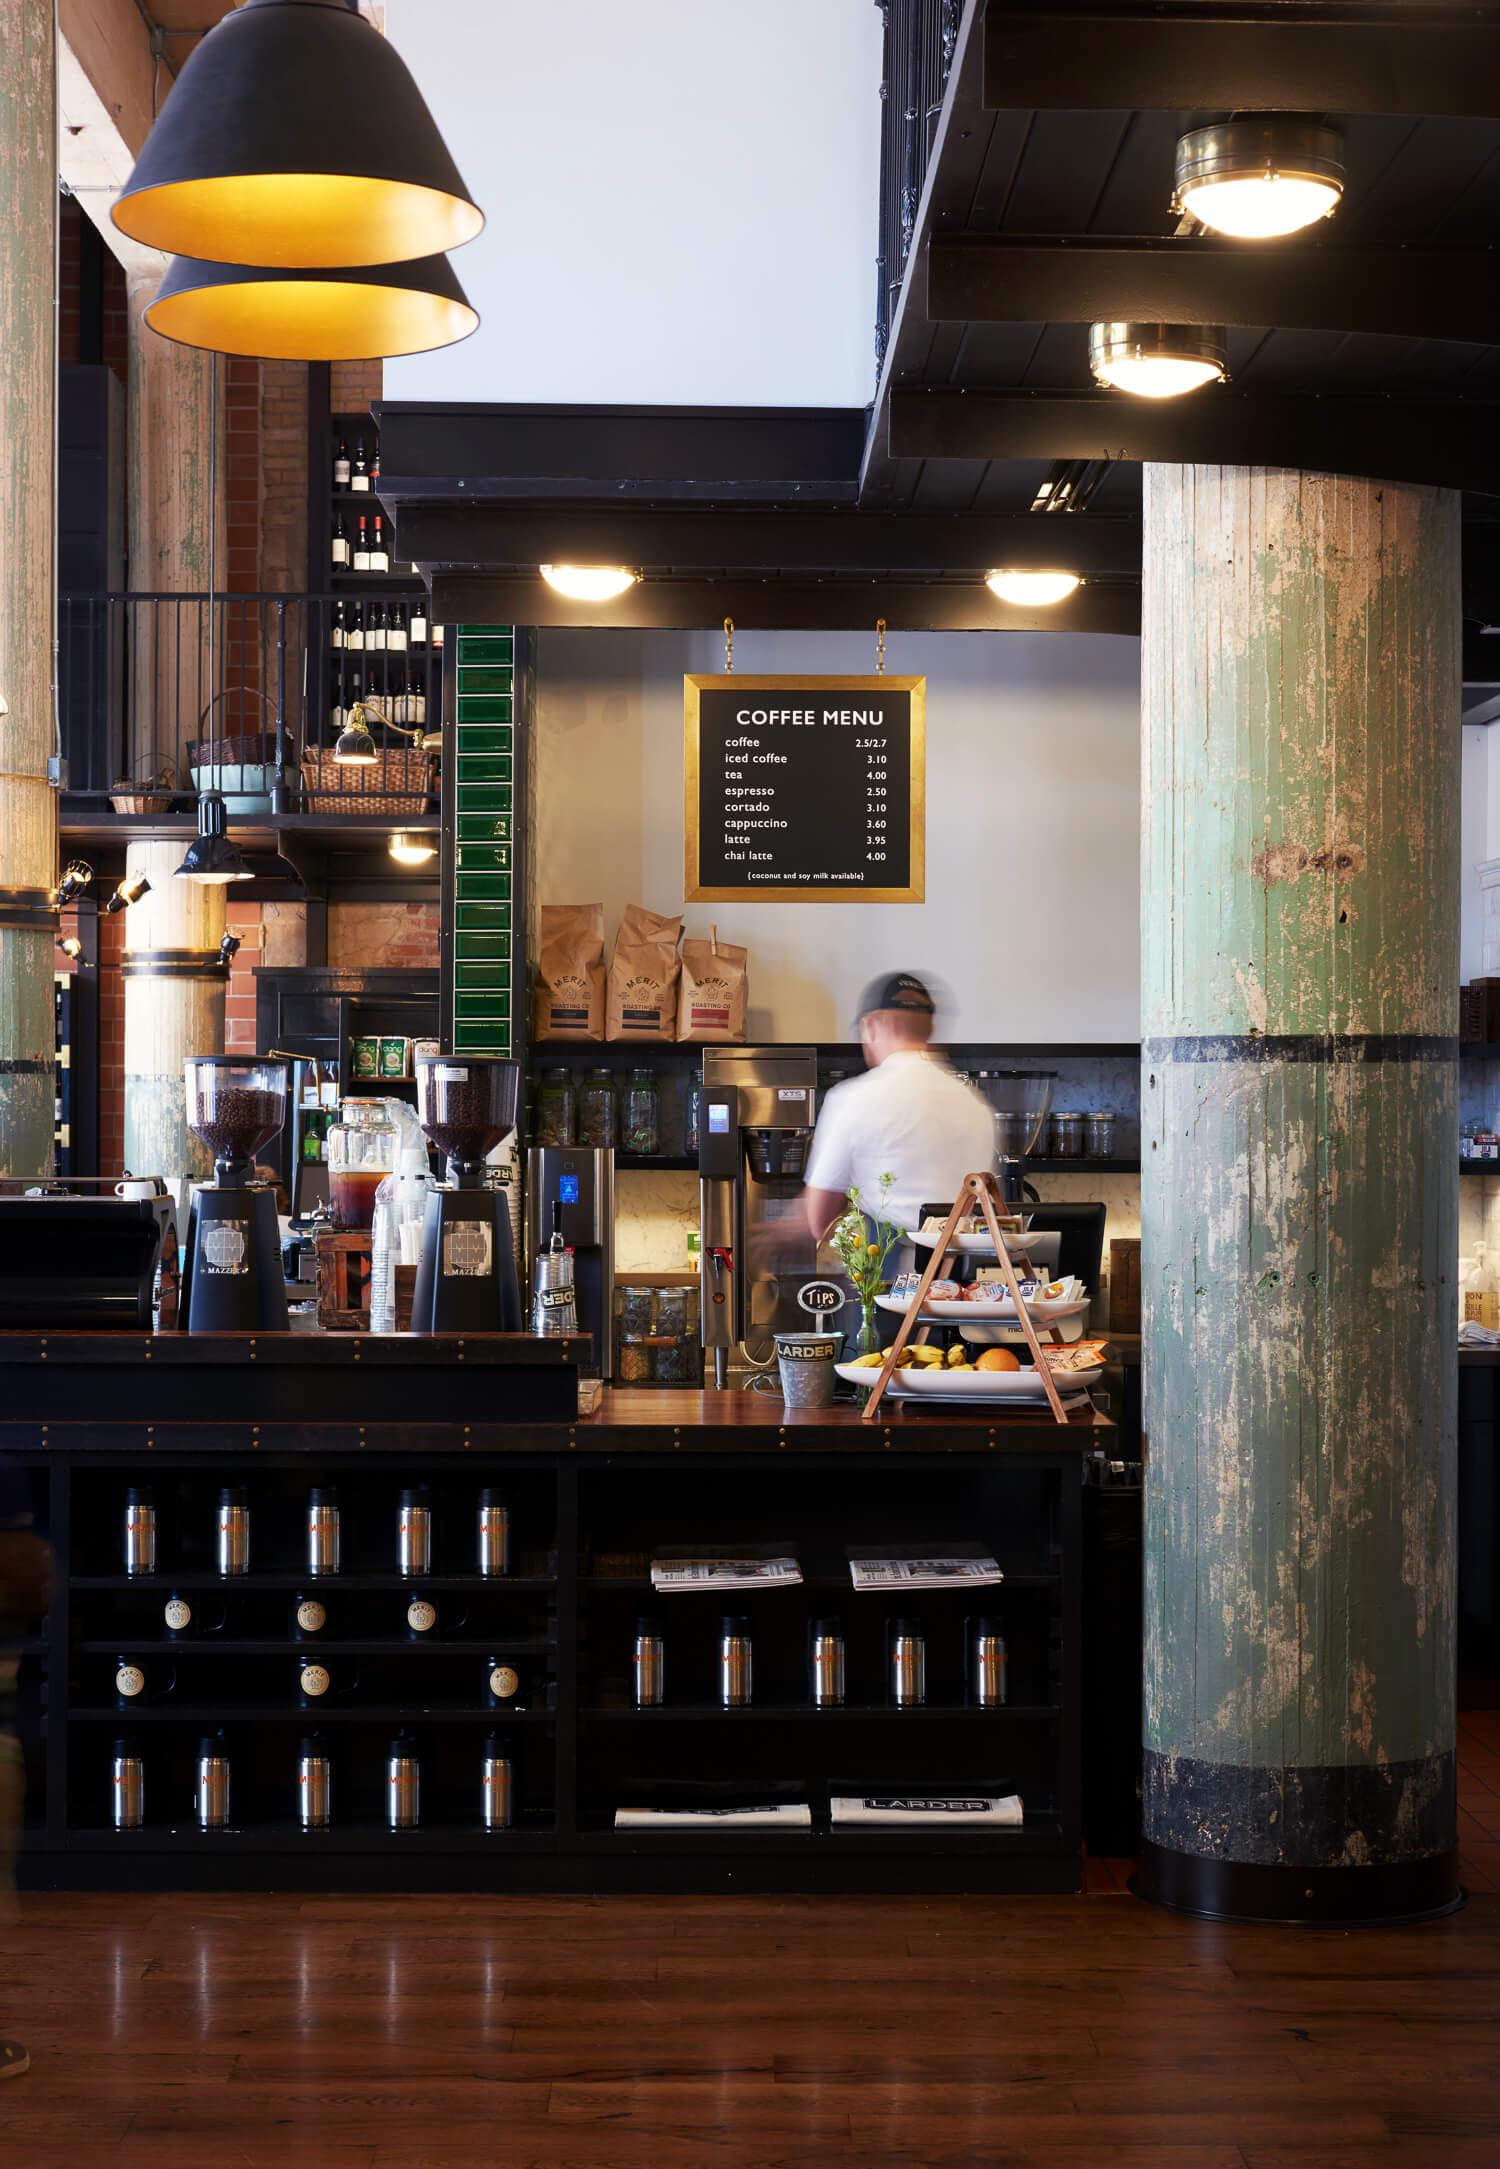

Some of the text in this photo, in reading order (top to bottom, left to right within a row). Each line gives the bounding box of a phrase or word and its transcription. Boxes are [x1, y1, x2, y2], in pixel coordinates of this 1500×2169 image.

[736, 710, 884, 725] COFFEE MENU
[725, 736, 760, 747] coffee
[855, 738, 887, 748] 2.5/2.7
[725, 752, 788, 763] iced coffee
[867, 755, 887, 764] 3.10
[725, 771, 743, 779] tea
[866, 771, 887, 780] 4.00
[725, 787, 775, 798] espresso
[866, 787, 887, 796] 2.50
[724, 801, 770, 812] cortado
[866, 803, 887, 812] 3.10
[724, 818, 788, 831] cappuccino
[866, 819, 887, 829] 3.60
[724, 833, 751, 844] latte
[866, 836, 887, 845] 3.95
[724, 850, 773, 860] chai latte
[866, 852, 886, 861] 4.00
[798, 872, 811, 881] soy
[553, 975, 588, 988] MERIT
[626, 976, 661, 989] MERIT
[382, 1045, 402, 1053] dang
[777, 1343, 834, 1358] LARDER
[871, 1799, 984, 1810] LARDER
